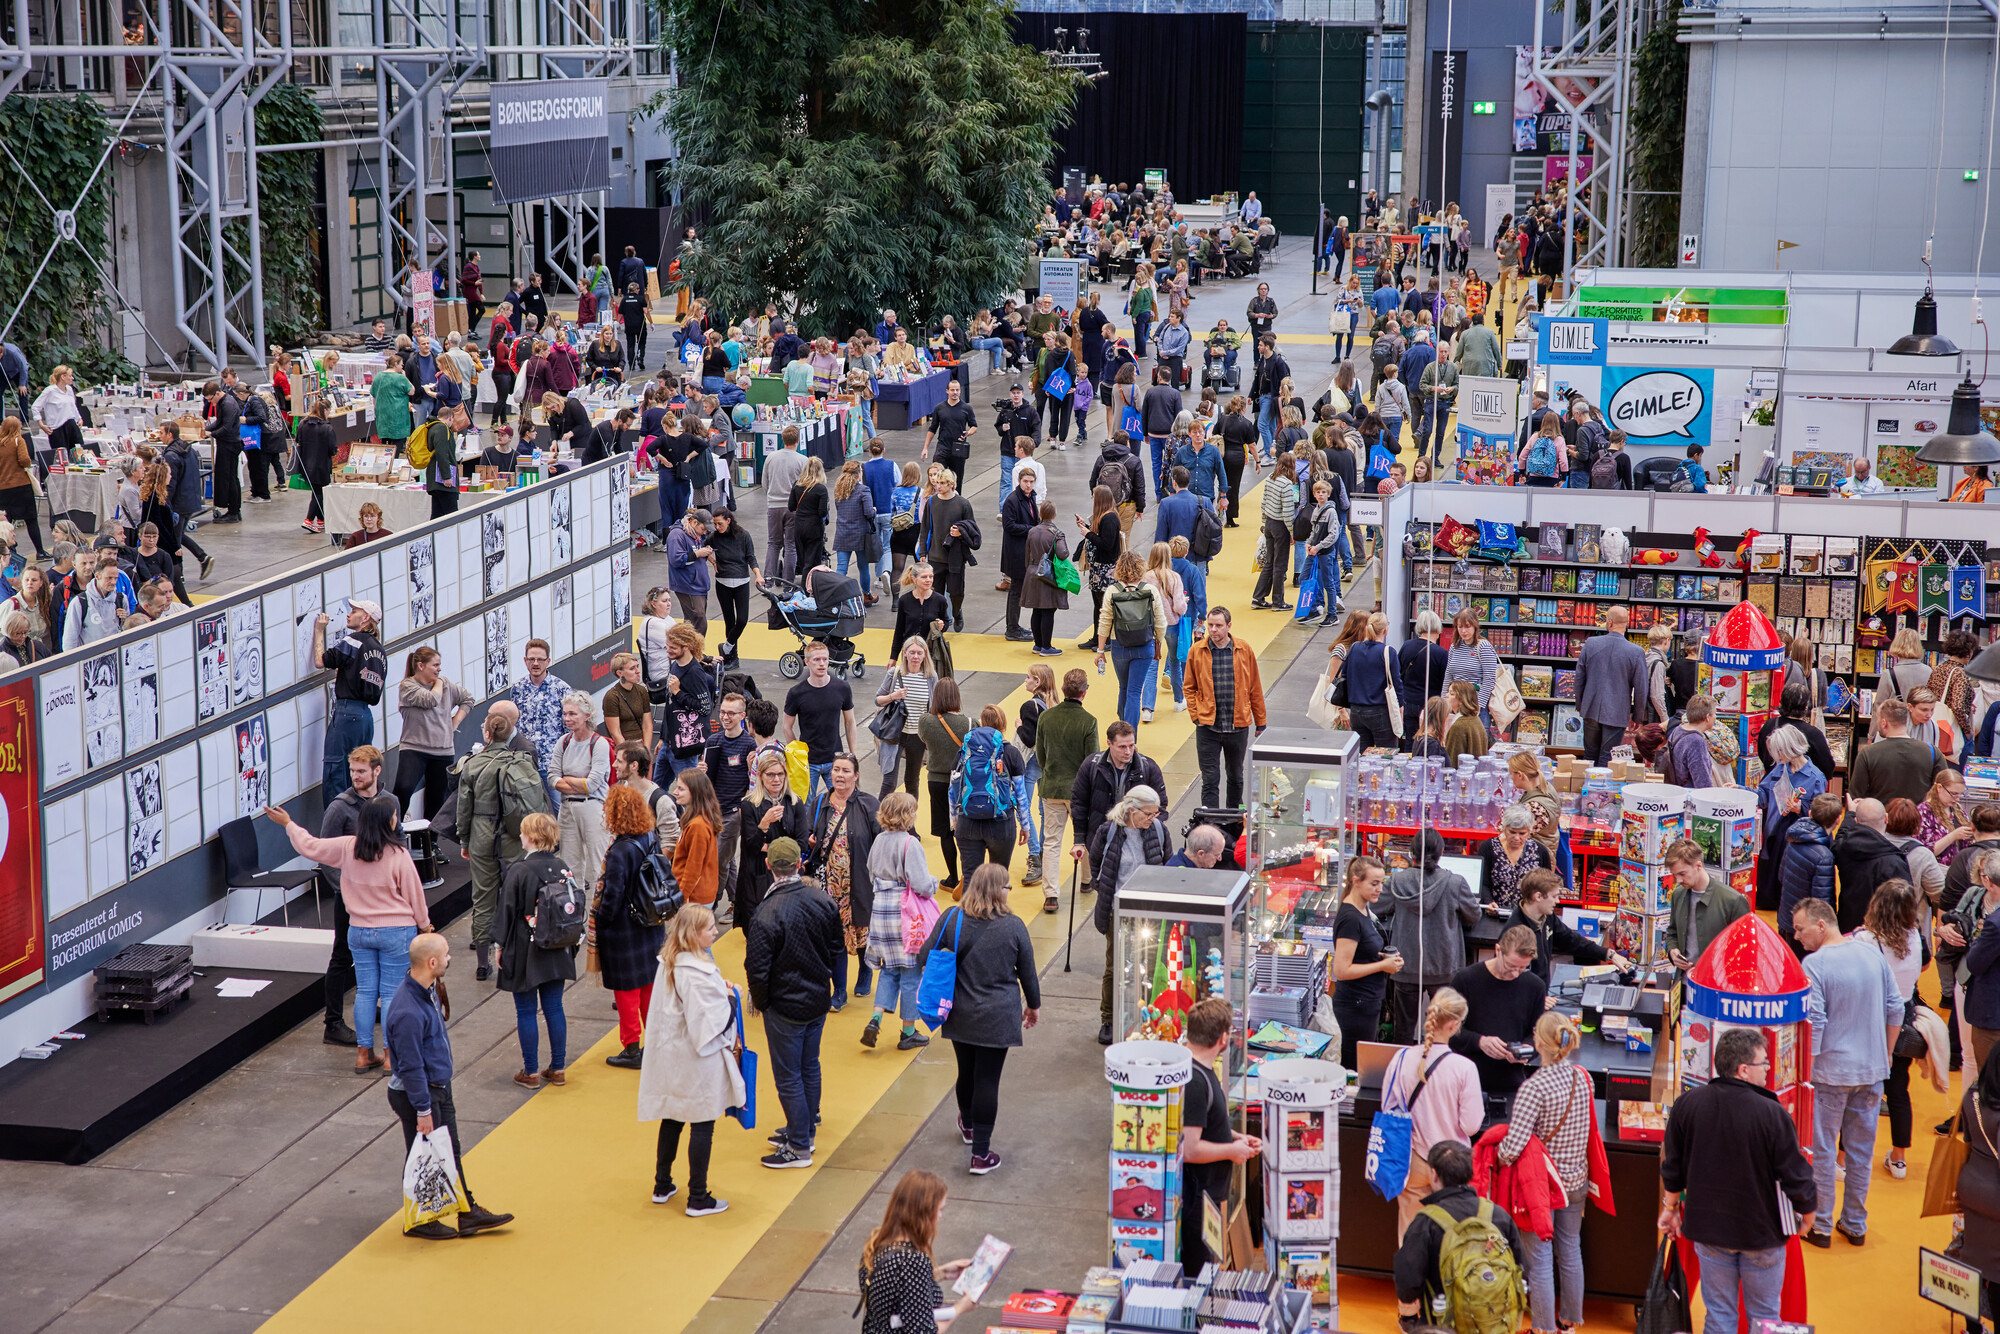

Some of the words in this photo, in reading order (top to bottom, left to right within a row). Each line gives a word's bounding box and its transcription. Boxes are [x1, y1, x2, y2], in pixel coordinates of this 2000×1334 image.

[1443, 55, 1455, 74] NY
[1441, 76, 1455, 119] SCENE
[498, 96, 603, 125] BØRNEBOGSFORUM
[1606, 307, 1642, 315] FORFATTER
[1553, 325, 1590, 349] GIMLE
[1906, 380, 1938, 391] Afart
[1475, 393, 1499, 414] GIMLE
[1616, 387, 1694, 420] GIMLE!
[1712, 650, 1749, 665] TINTIN
[1637, 802, 1669, 812] ZOOM
[1712, 808, 1744, 817] ZOOM
[51, 910, 107, 950] Præsenteret
[108, 901, 118, 921] af
[52, 929, 107, 972] BOGFORUM
[107, 910, 143, 942] COMICS
[1720, 998, 1784, 1019] TINTIN
[1155, 1069, 1189, 1086] ZOOM
[1119, 1091, 1159, 1102] VIGGO
[1267, 1087, 1306, 1103] ZOOM
[1118, 1158, 1158, 1169] VIGGO
[1286, 1152, 1324, 1168] SODA
[1118, 1226, 1158, 1235] VIGGO
[1286, 1221, 1325, 1236] SODA
[1930, 1259, 1948, 1272] MESSE
[1949, 1265, 1970, 1281] TILBUD
[1931, 1274, 1945, 1290] KR
